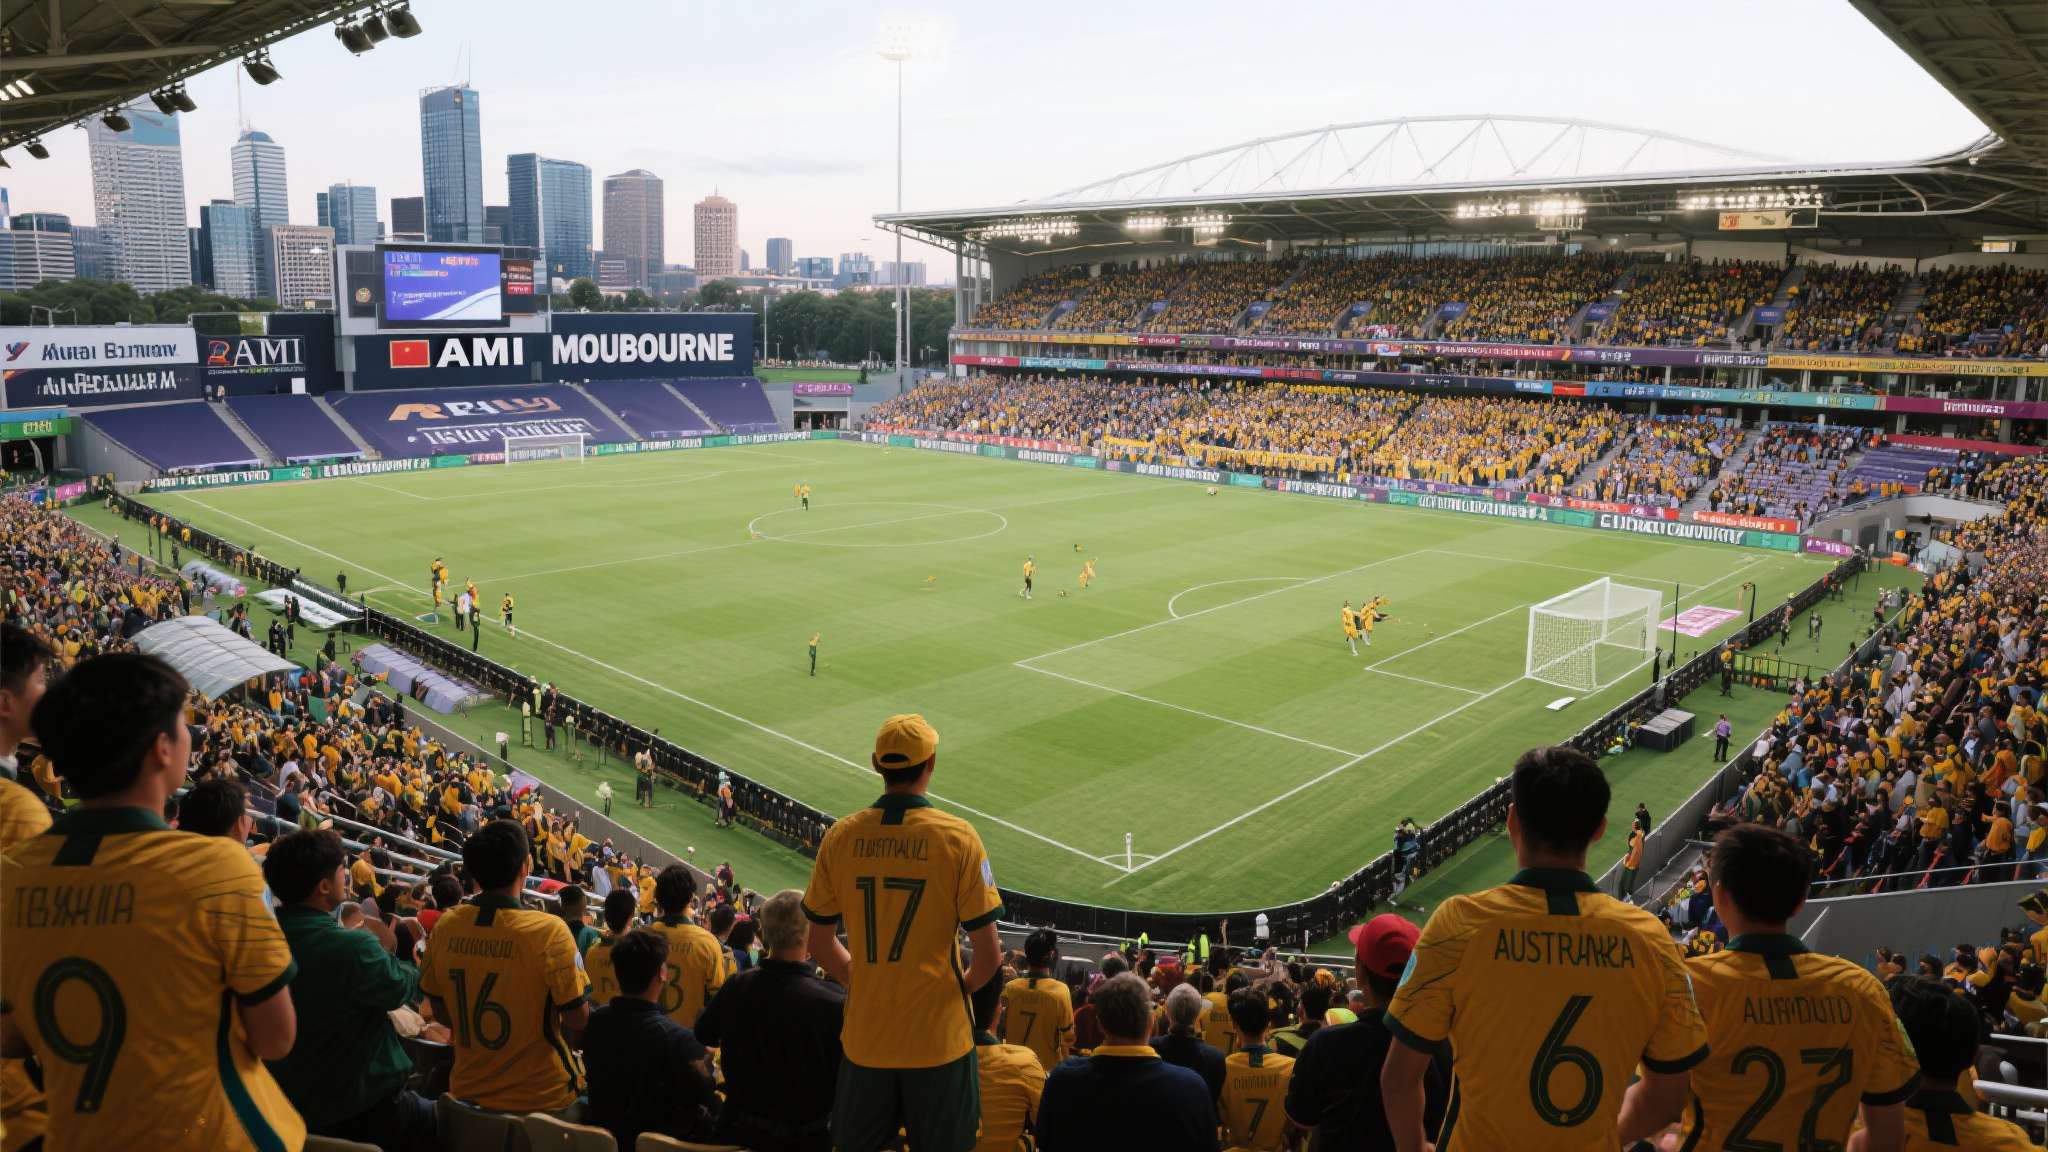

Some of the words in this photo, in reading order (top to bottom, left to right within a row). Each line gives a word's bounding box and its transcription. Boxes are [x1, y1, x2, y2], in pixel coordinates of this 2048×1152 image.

[436, 337, 524, 367] AMI
[552, 333, 734, 365] MOUBOURNE
[855, 876, 927, 962] 17
[33, 956, 127, 1115] 9
[448, 968, 511, 1050] 16
[1530, 995, 1604, 1128] 6
[1245, 1097, 1268, 1141] 7
